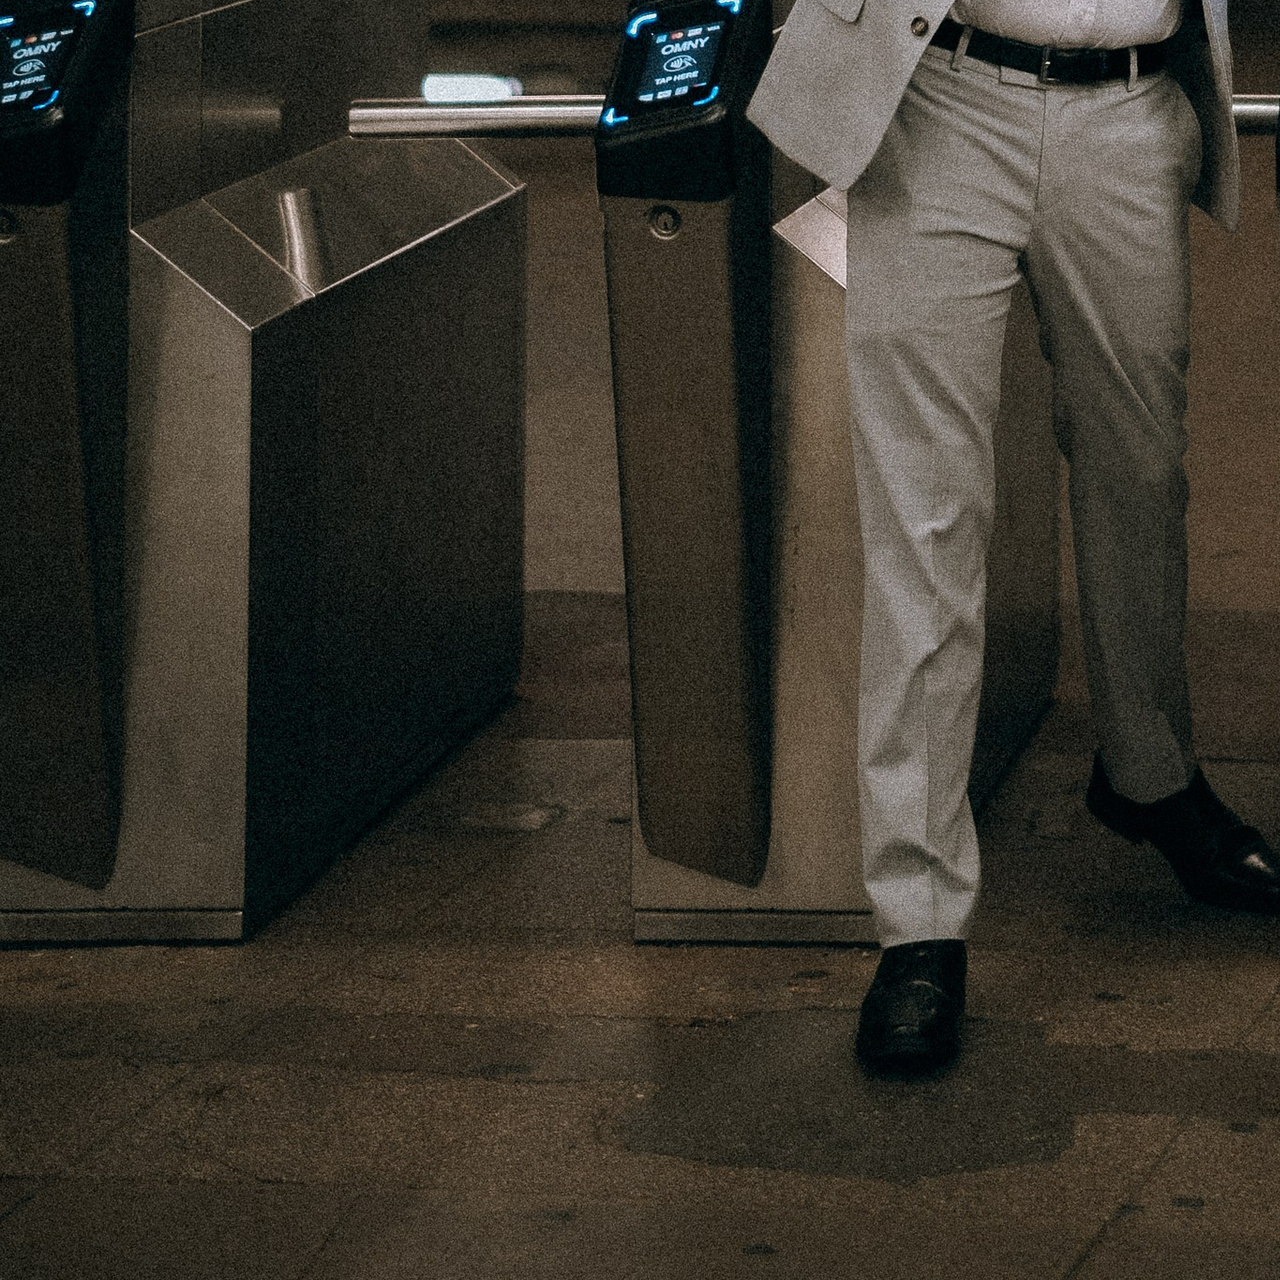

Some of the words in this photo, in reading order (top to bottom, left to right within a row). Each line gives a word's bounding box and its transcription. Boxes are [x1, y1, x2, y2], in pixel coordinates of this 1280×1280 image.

[13, 41, 61, 59] OMNY
[661, 36, 710, 55] OMNY
[2, 80, 20, 89] TAP
[20, 74, 46, 86] HERE
[654, 76, 673, 85] TAP
[673, 70, 699, 81] HERE
